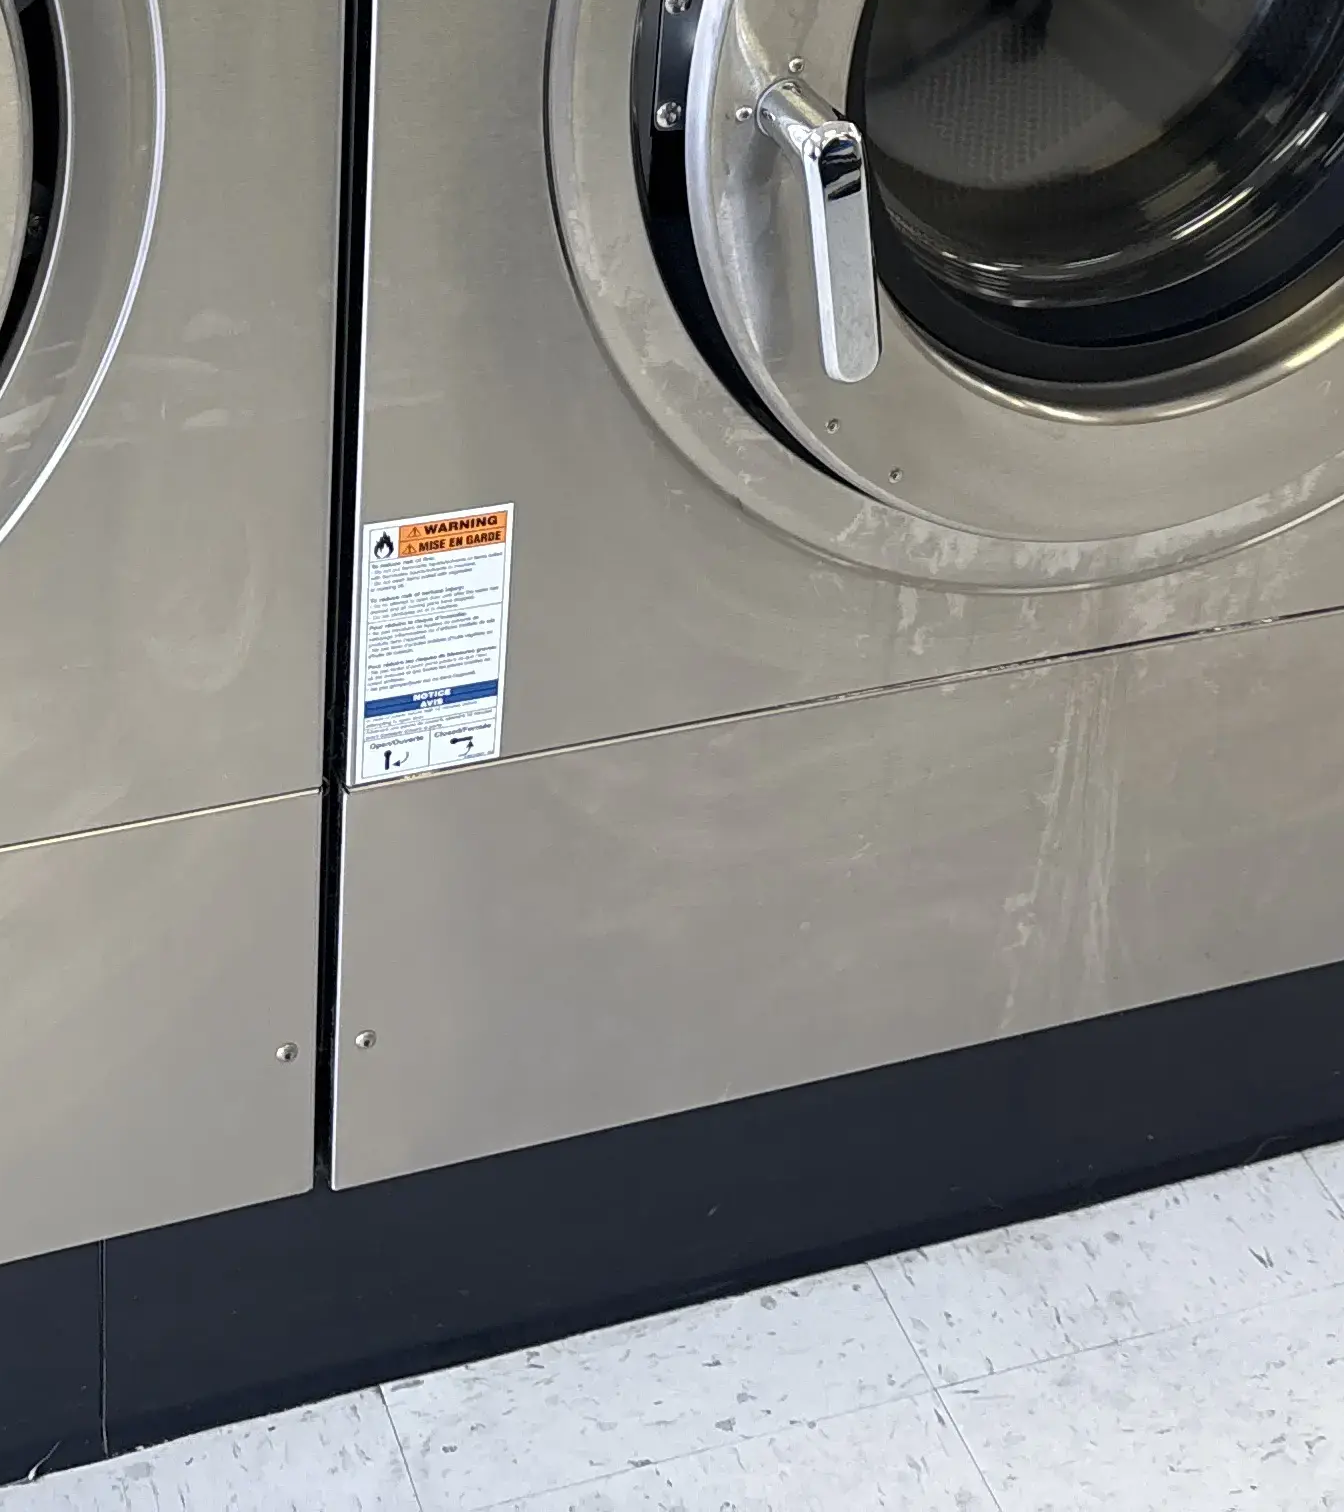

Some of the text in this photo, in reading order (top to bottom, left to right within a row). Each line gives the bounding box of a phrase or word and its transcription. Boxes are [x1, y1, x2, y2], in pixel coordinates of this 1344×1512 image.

[424, 515, 498, 535] WARNING
[418, 531, 502, 552] MISE EN GARDE
[412, 688, 452, 701] NOTICE
[420, 698, 444, 708] AVIS
